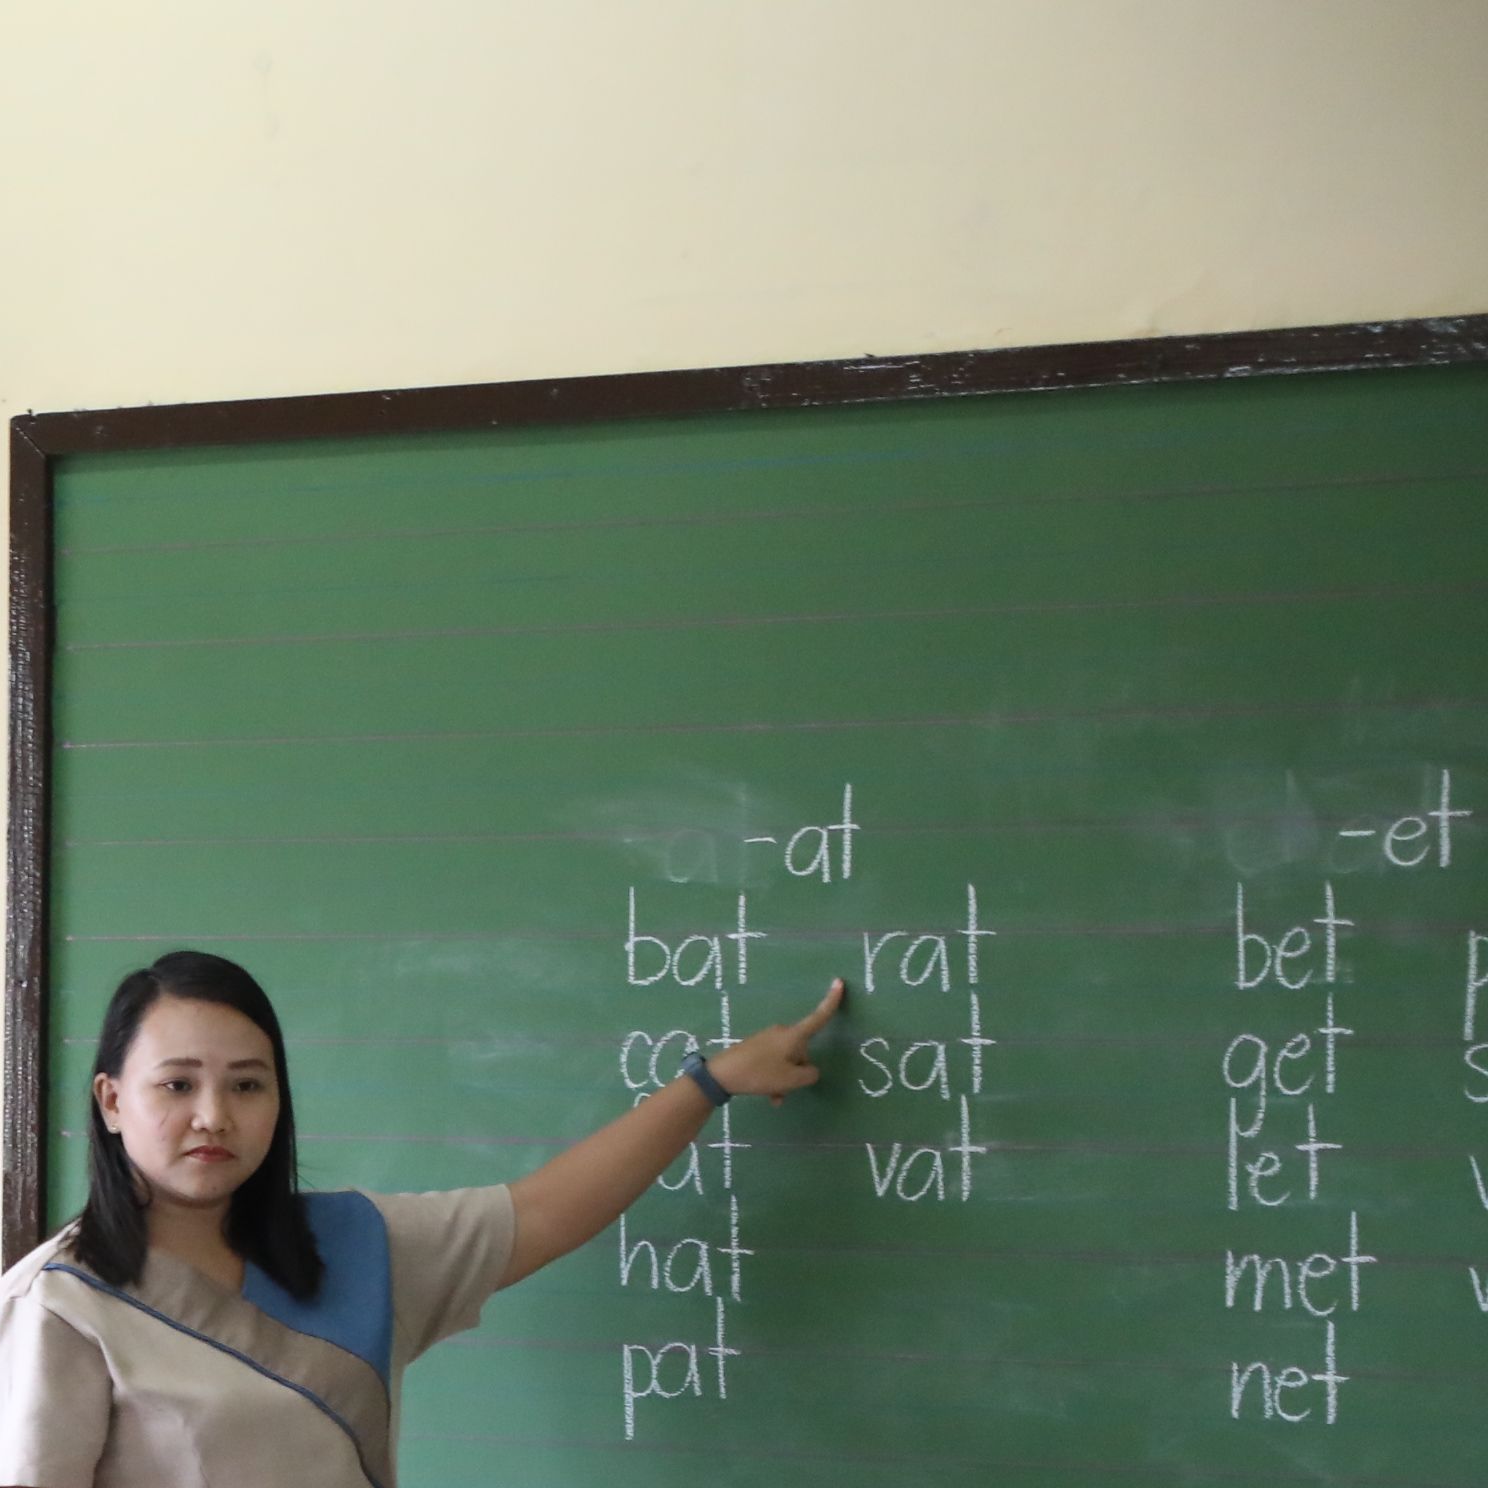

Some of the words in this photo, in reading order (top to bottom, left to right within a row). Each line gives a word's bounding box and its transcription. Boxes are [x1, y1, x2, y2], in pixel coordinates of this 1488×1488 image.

[624, 886, 768, 989] bat
[862, 883, 997, 994] rat
[1235, 882, 1355, 990] bet
[859, 994, 997, 1100] sat
[1222, 995, 1354, 1137] get
[633, 1092, 751, 1195] at
[866, 1095, 988, 1201] vat
[1228, 1098, 1343, 1211] let
[619, 1195, 755, 1302] hat
[1225, 1211, 1378, 1317] met
[622, 1296, 742, 1441] pat
[1230, 1320, 1350, 1425] net
